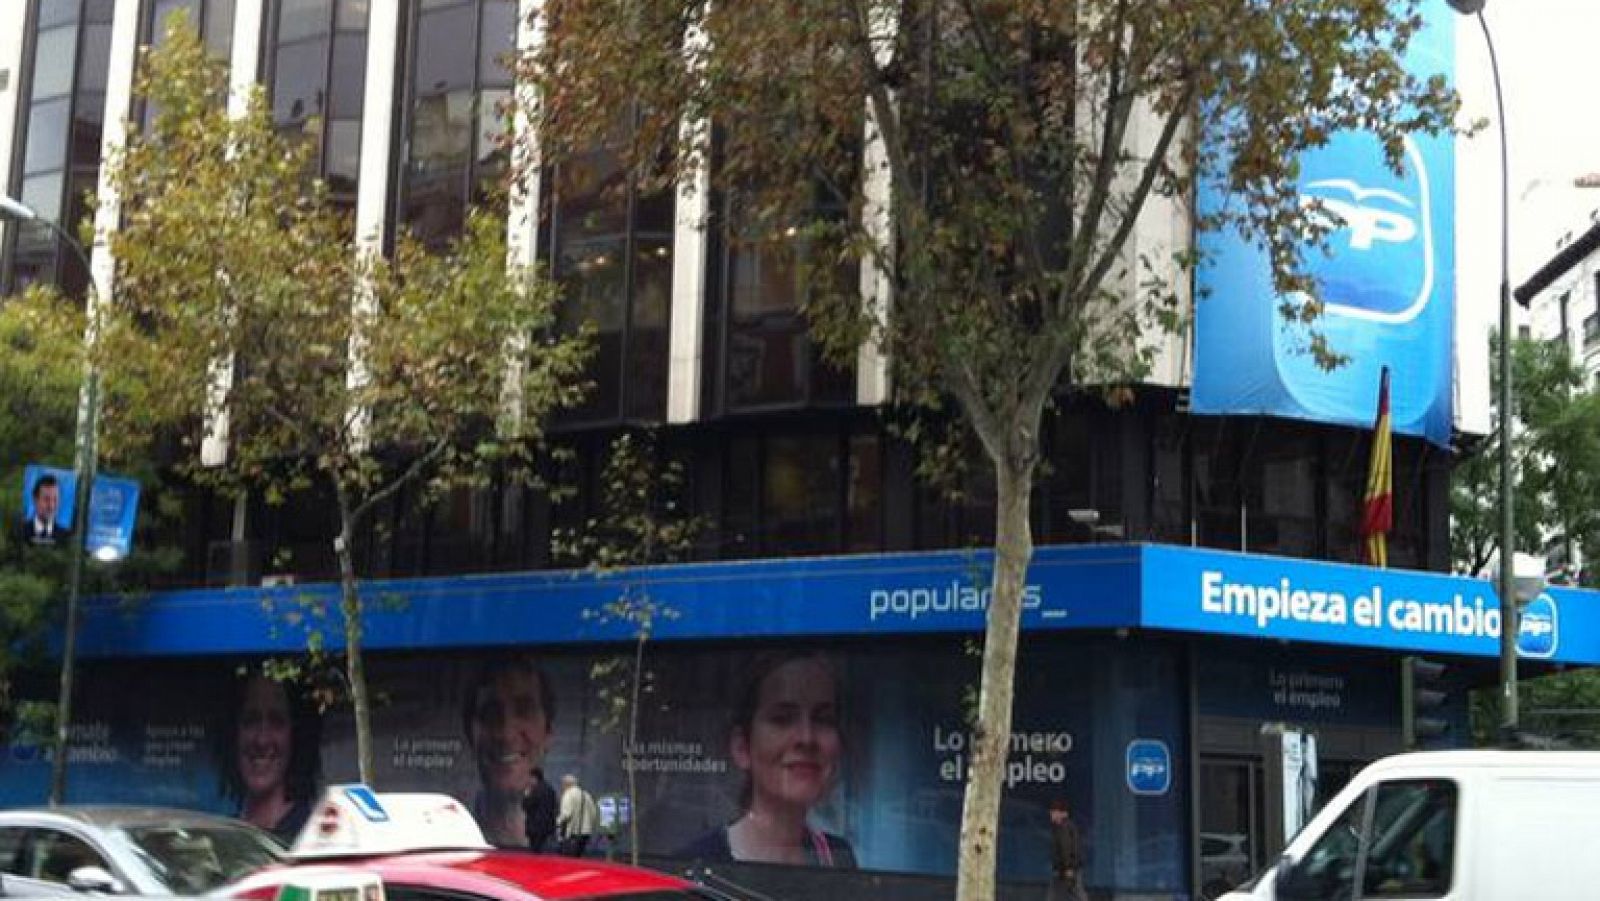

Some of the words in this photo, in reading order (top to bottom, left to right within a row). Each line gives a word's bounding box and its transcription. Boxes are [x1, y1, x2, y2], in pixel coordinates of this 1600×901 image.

[1201, 570, 1347, 628] Empieza
[1353, 587, 1382, 628] el
[1388, 594, 1500, 638] cambio
[933, 727, 964, 751] Lo
[940, 755, 962, 780] el
